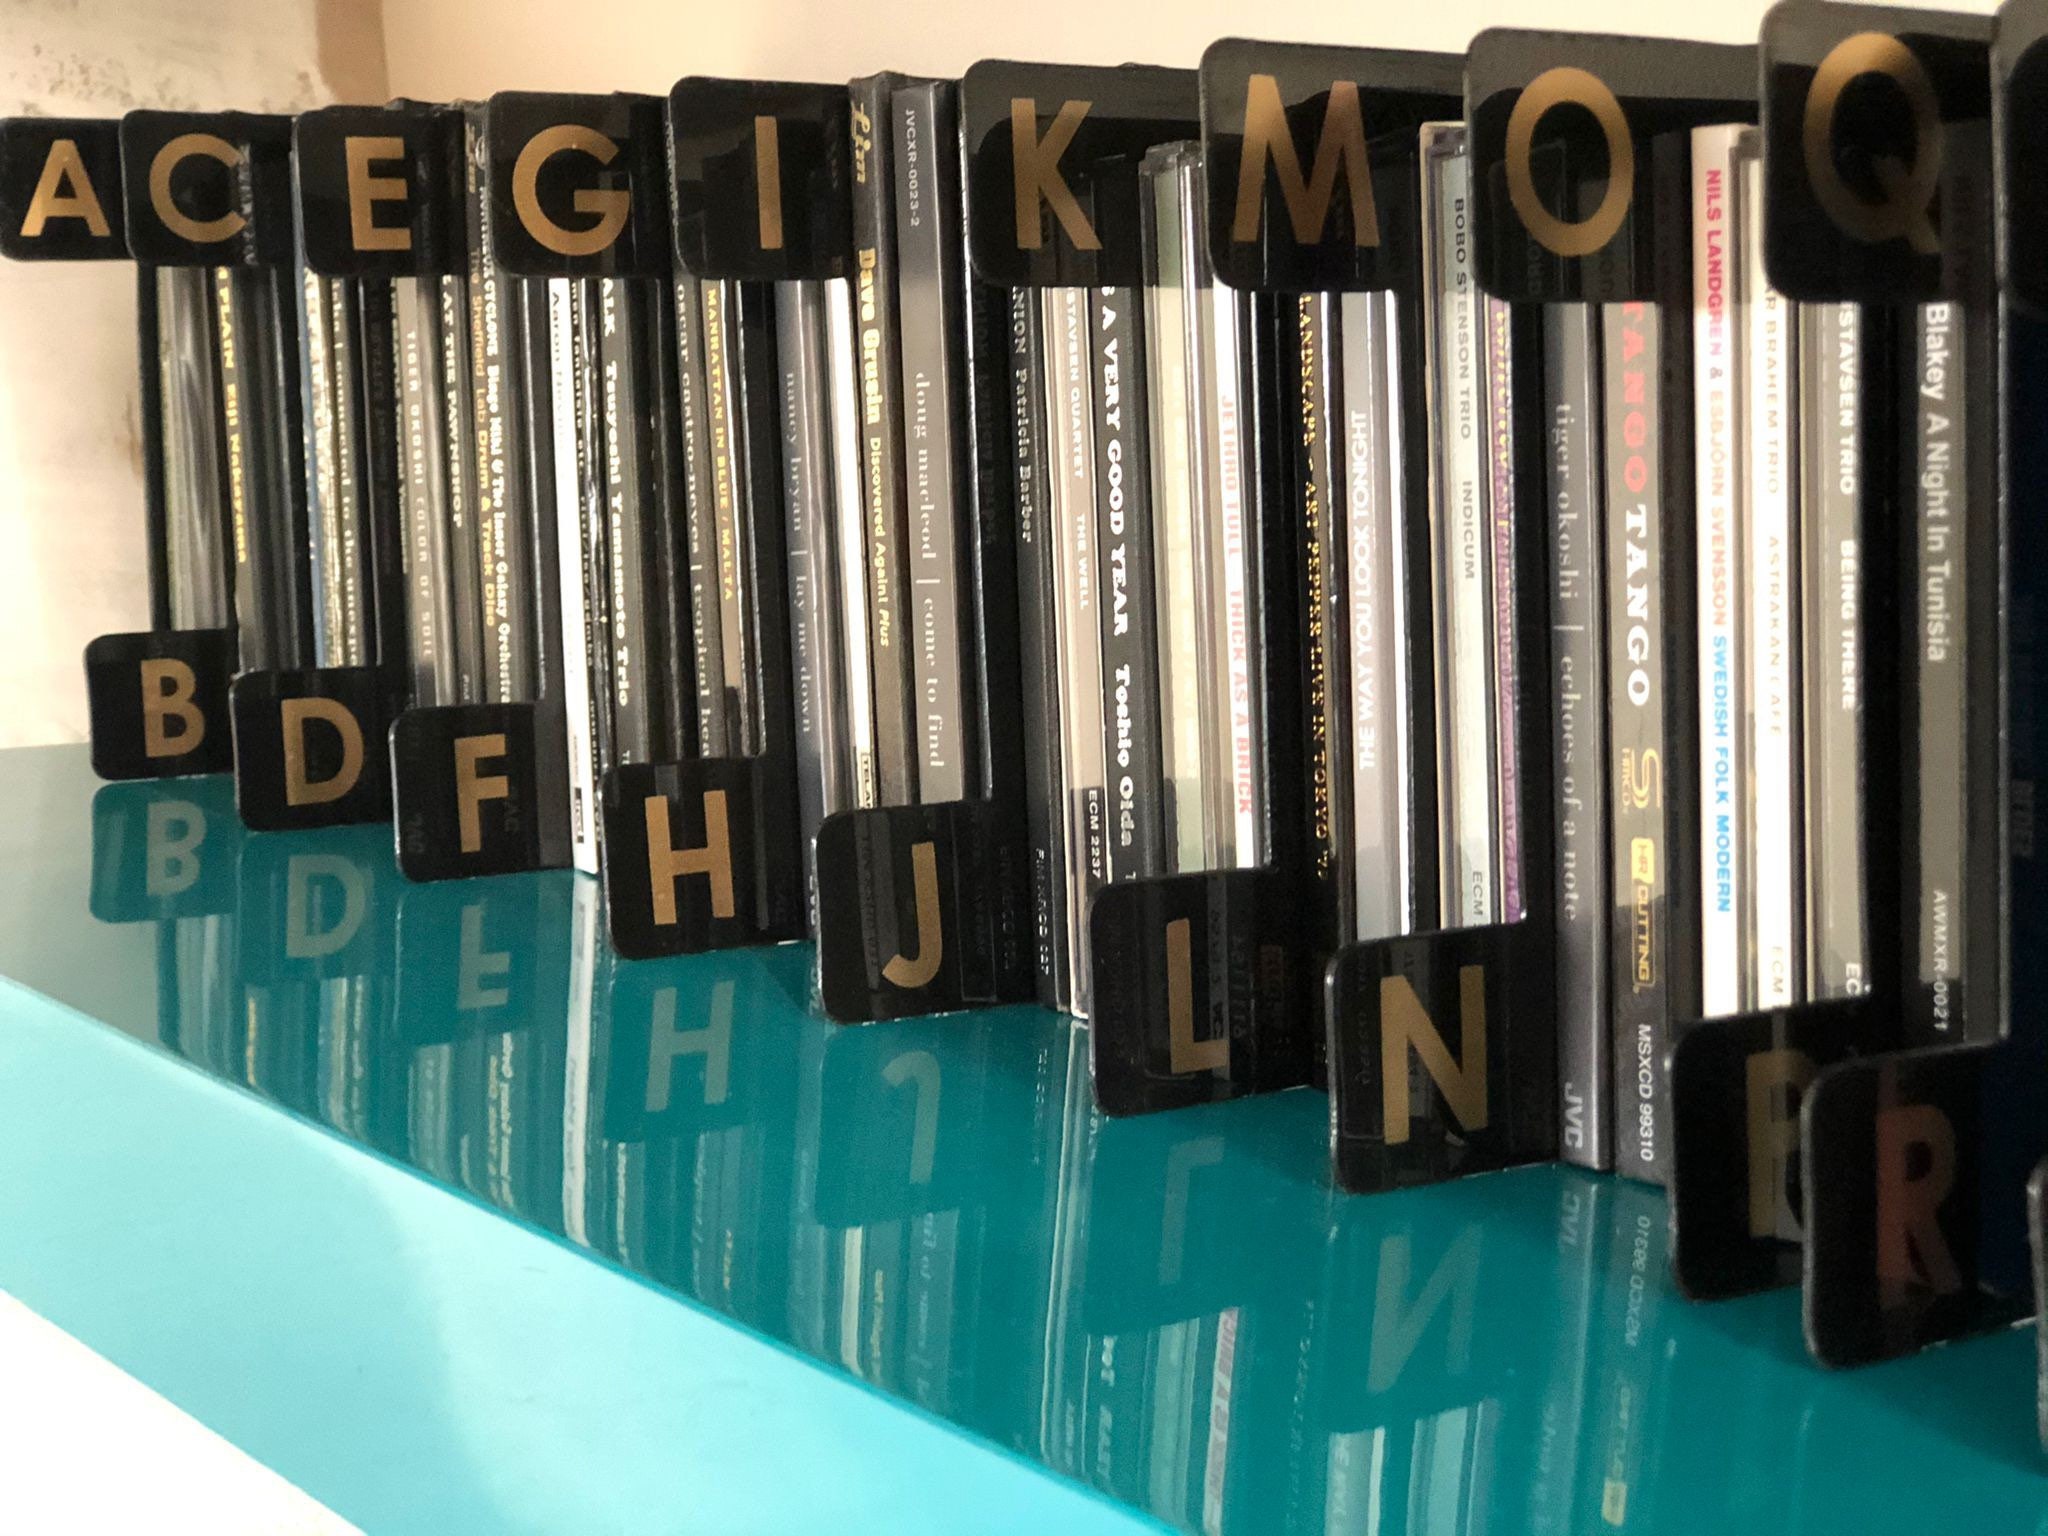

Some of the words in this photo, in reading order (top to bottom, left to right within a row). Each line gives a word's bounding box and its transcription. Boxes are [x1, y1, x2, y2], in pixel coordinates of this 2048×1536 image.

[904, 109, 920, 227] JVCXR-0023-2
[1010, 97, 1103, 251] K
[1232, 74, 1381, 248] M
[1505, 66, 1634, 257] O
[1803, 31, 1945, 255] Q
[21, 140, 110, 237] A
[149, 133, 246, 243] C
[345, 136, 412, 251] E
[512, 125, 630, 256] G
[754, 115, 783, 250] I
[1706, 169, 1722, 221] NILS
[470, 248, 482, 283] The
[1454, 198, 1467, 264] BOBO
[442, 292, 455, 325] AT
[483, 280, 498, 355] CYCLONE
[676, 284, 690, 362] oscar
[857, 248, 879, 322] Dave
[1102, 305, 1117, 331] A
[1707, 230, 1723, 356] LANDGREN
[406, 331, 419, 392] TIGER
[444, 333, 458, 384] THE
[472, 296, 486, 376] Sheffield
[551, 292, 562, 361] Aaron
[707, 288, 724, 420] MANHATTAN
[1066, 288, 1079, 381] STAVSEN
[1456, 272, 1470, 379] STENSON
[1920, 303, 1951, 400] Blakey
[486, 365, 500, 414] Bingo
[862, 328, 884, 425] Grusin
[1103, 338, 1121, 431] VERY
[1299, 295, 1316, 447] LANDSCAPE
[1623, 302, 1649, 492] TANGO
[1709, 366, 1722, 380] &
[1765, 320, 1779, 428] BRAHEM
[1838, 304, 1855, 427] STAVSEN
[219, 287, 235, 369] PLAIN
[229, 434, 247, 563] Nakayama
[337, 361, 352, 485] connected
[475, 389, 487, 422] Lab
[489, 417, 503, 455] Miki
[605, 361, 622, 485] Tsuyoshi
[714, 427, 725, 448] IN
[785, 373, 798, 445] nancy
[913, 372, 931, 438] doug
[1014, 368, 1031, 458] Patricia
[1069, 387, 1084, 479] QUARTET
[1221, 395, 1238, 490] JETHRO
[1460, 387, 1471, 440] TRIO
[1552, 404, 1575, 479] tiger
[1710, 390, 1727, 496] ESBJÖRN
[1926, 412, 1950, 435] A
[410, 404, 424, 485] OKOSHI
[446, 390, 462, 528] PAWNSHOP
[478, 430, 489, 488] Drum
[681, 372, 700, 553] castro-neves
[717, 456, 728, 508] BLUE
[1351, 410, 1369, 519] TONIGHT
[1767, 439, 1779, 494] TRIO
[1839, 434, 1855, 495] TRIO
[1921, 441, 1950, 518] Night
[342, 496, 352, 519] to
[480, 496, 490, 511] &
[492, 477, 505, 508] The
[788, 456, 803, 532] bryan
[867, 437, 886, 537] Discovered
[917, 448, 937, 559] macleod
[1018, 465, 1034, 543] Barber
[1107, 440, 1124, 535] GOOD
[344, 530, 356, 567] the
[416, 497, 429, 562] COLOR
[482, 519, 494, 576] Track
[493, 512, 507, 557] Inner
[610, 492, 628, 639] Yamamoto
[722, 529, 734, 600] MALTA
[1075, 513, 1087, 551] THE
[1226, 499, 1241, 558] TULL
[1353, 526, 1372, 597] LOOK
[1462, 481, 1475, 580] INDICUM
[1556, 491, 1580, 600] okoshi
[1712, 506, 1727, 626] SVENSSON
[1927, 526, 1950, 552] In
[419, 575, 430, 602] OF
[485, 583, 495, 626] Disc
[495, 561, 509, 617] Galaxy
[794, 574, 810, 611] lay
[874, 542, 889, 603] Again!
[1078, 558, 1090, 610] WELL
[1111, 543, 1128, 636] YEAR
[1307, 542, 1323, 637] PEPPER
[1624, 504, 1651, 707] TANGO
[1768, 536, 1781, 666] ASTRAKAN
[1840, 539, 1856, 620] BEING
[1926, 559, 1951, 662] Tunisia
[498, 623, 512, 703] Orchestra
[691, 583, 710, 697] tropical
[798, 623, 809, 658] me
[879, 609, 892, 648] Plus
[923, 598, 937, 667] come
[1229, 589, 1247, 661] THICK
[1355, 603, 1373, 656] YOU
[616, 646, 630, 706] Trio
[800, 665, 813, 733] down
[925, 678, 939, 703] to
[1232, 671, 1248, 702] AS
[1310, 647, 1325, 705] LIVE
[1357, 663, 1375, 720] WAY
[1712, 635, 1729, 736] SWEDISH
[1841, 627, 1856, 711] THERE
[140, 658, 206, 758] B
[928, 714, 945, 767] find
[1115, 664, 1132, 767] Toshio
[1235, 712, 1250, 728] A
[1312, 715, 1326, 741] IN
[1560, 656, 1582, 763] echoes
[280, 697, 365, 806] D
[1236, 737, 1252, 815] BRICK
[1358, 727, 1376, 770] THE
[1715, 746, 1730, 804] FOLK
[453, 733, 510, 853] F
[1088, 790, 1099, 830] ECM
[1119, 776, 1135, 847] Oida
[1314, 750, 1328, 839] TOKYO
[1562, 776, 1583, 811] of
[1563, 820, 1577, 836] a
[644, 790, 734, 926] H
[1091, 835, 1102, 878] 2237
[1471, 871, 1484, 916] ECM
[1562, 851, 1581, 922] note
[1716, 815, 1731, 912] MODERN
[882, 841, 944, 989] J
[1637, 885, 1651, 981] CUTTING
[1166, 917, 1231, 1074] L
[1933, 889, 1949, 1030] AWMXR-0021
[1379, 964, 1489, 1146] N
[1637, 1024, 1652, 1099] MSXCD
[1563, 1082, 1584, 1149] JVC
[1639, 1103, 1654, 1162] 99310
[1875, 1104, 1963, 1297] R
